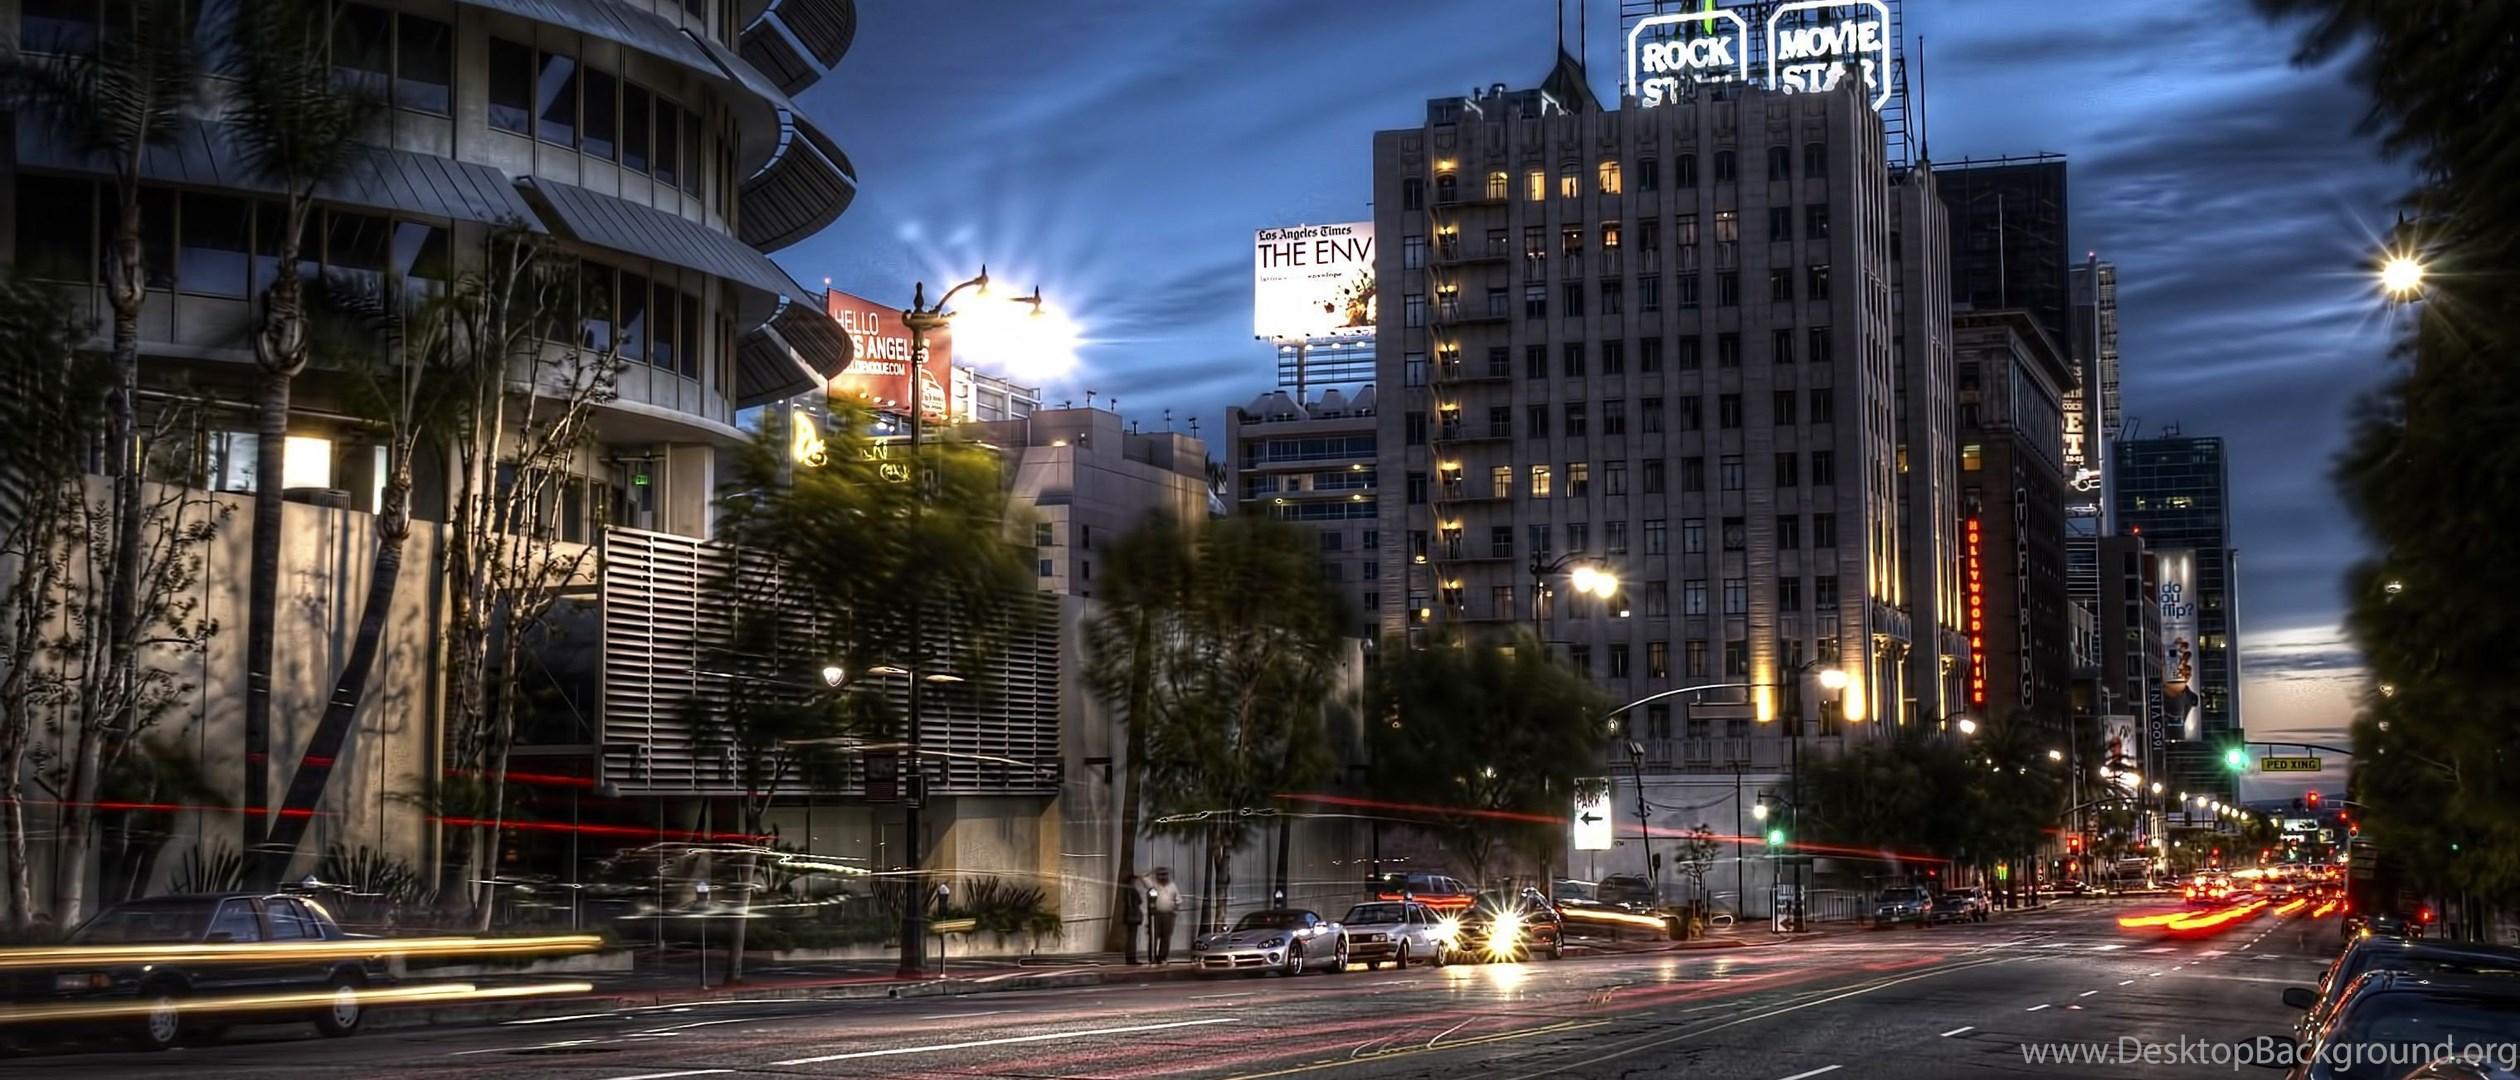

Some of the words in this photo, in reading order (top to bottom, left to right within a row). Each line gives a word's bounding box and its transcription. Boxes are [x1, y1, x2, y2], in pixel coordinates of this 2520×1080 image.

[1642, 36, 1735, 73] ROCK
[1777, 20, 1882, 60] MOVIE
[1782, 59, 1877, 95] STAR
[1259, 230, 1277, 242] Los
[1279, 227, 1318, 240] Angeles
[1320, 225, 1352, 237] Times
[1258, 241, 1306, 269] THE
[1316, 236, 1373, 265] ENV
[834, 309, 879, 336] HELLO
[867, 337, 930, 363] ANGELS
[2017, 503, 2029, 594] TAFT
[1969, 520, 1980, 631] HOLLYWOOD
[2161, 581, 2182, 594] do
[2162, 602, 2194, 619] flip?
[2020, 609, 2032, 697] BLDG
[1974, 653, 1983, 702] VINE
[2153, 721, 2161, 751] 1600
[2267, 760, 2288, 769] PED
[2291, 760, 2316, 769] XING
[1576, 794, 1601, 809] PARK
